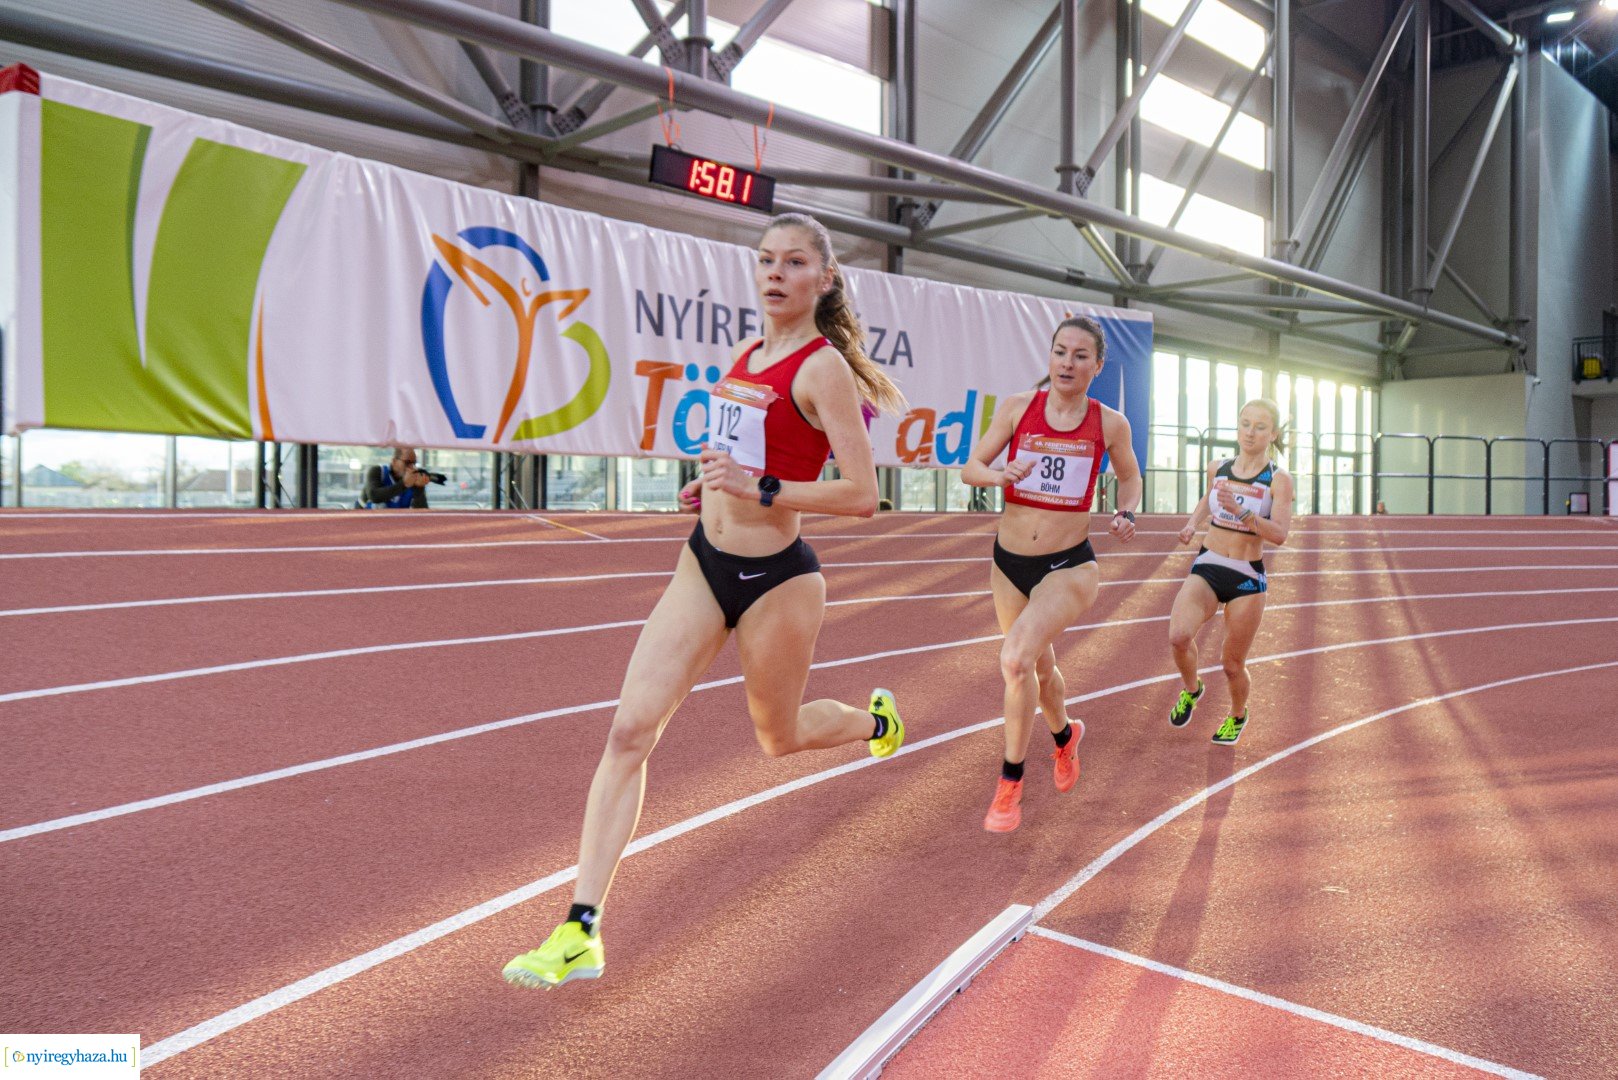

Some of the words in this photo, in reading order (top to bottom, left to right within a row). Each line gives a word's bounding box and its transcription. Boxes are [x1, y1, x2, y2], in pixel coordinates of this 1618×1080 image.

[689, 159, 752, 203] 1:58.1
[718, 402, 742, 441] 112
[1040, 455, 1066, 481] 38
[1040, 482, 1061, 494] BÖHM
